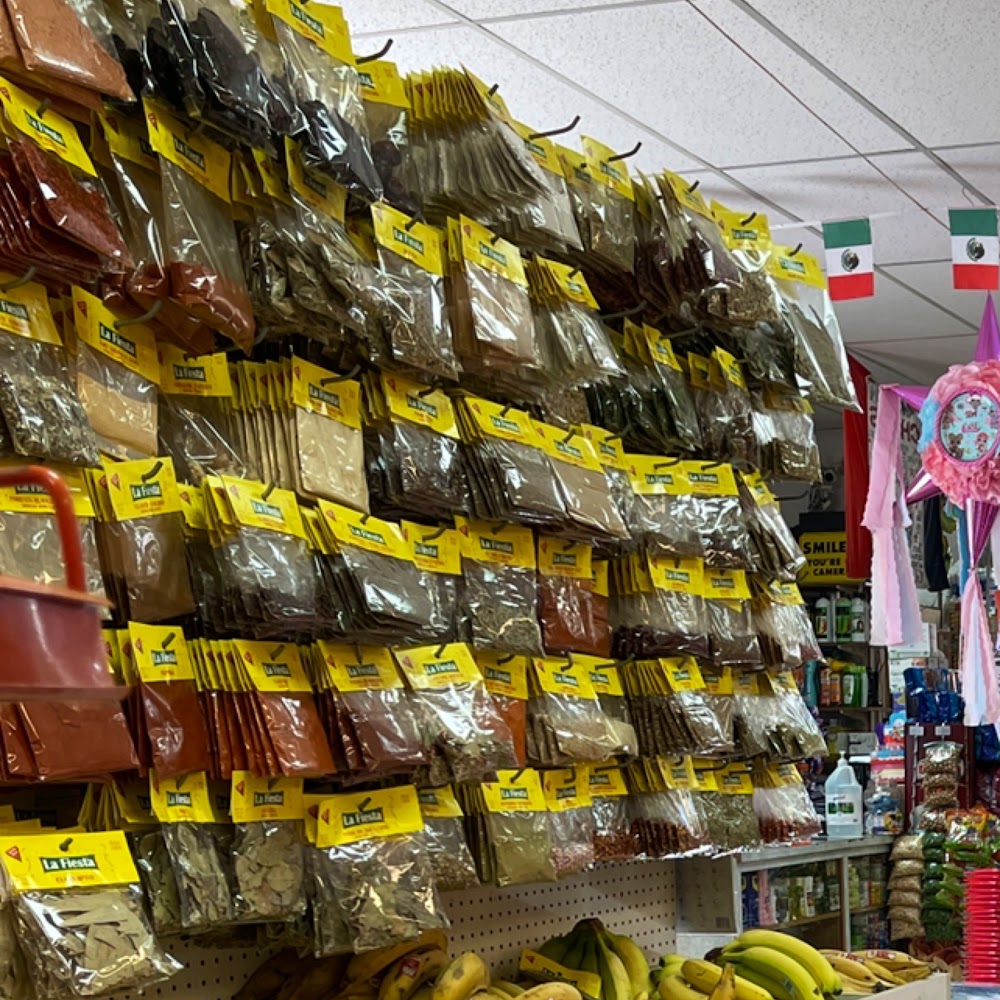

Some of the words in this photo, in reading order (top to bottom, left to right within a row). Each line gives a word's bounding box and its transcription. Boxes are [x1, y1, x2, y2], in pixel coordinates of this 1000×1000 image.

[101, 325, 113, 343] La
[112, 331, 134, 355] Fiesta
[175, 366, 186, 378] La
[184, 366, 204, 380] Fiesta
[132, 485, 143, 499] La
[140, 483, 161, 498] Fiesta
[803, 541, 847, 553] SMILE
[808, 558, 841, 567] YOU'RE
[813, 567, 845, 576] CAMER
[159, 651, 176, 664] Fiesta
[348, 665, 361, 675] La
[357, 665, 378, 675] Fiesta
[425, 664, 438, 674] La
[435, 662, 457, 673] Fiesta
[174, 793, 191, 805] Fiesta
[256, 793, 265, 804] La
[264, 793, 283, 804] Fiesta
[344, 813, 358, 827] La
[356, 809, 382, 825] Fiesta
[43, 857, 64, 871] La
[59, 855, 96, 869] Fiesta
